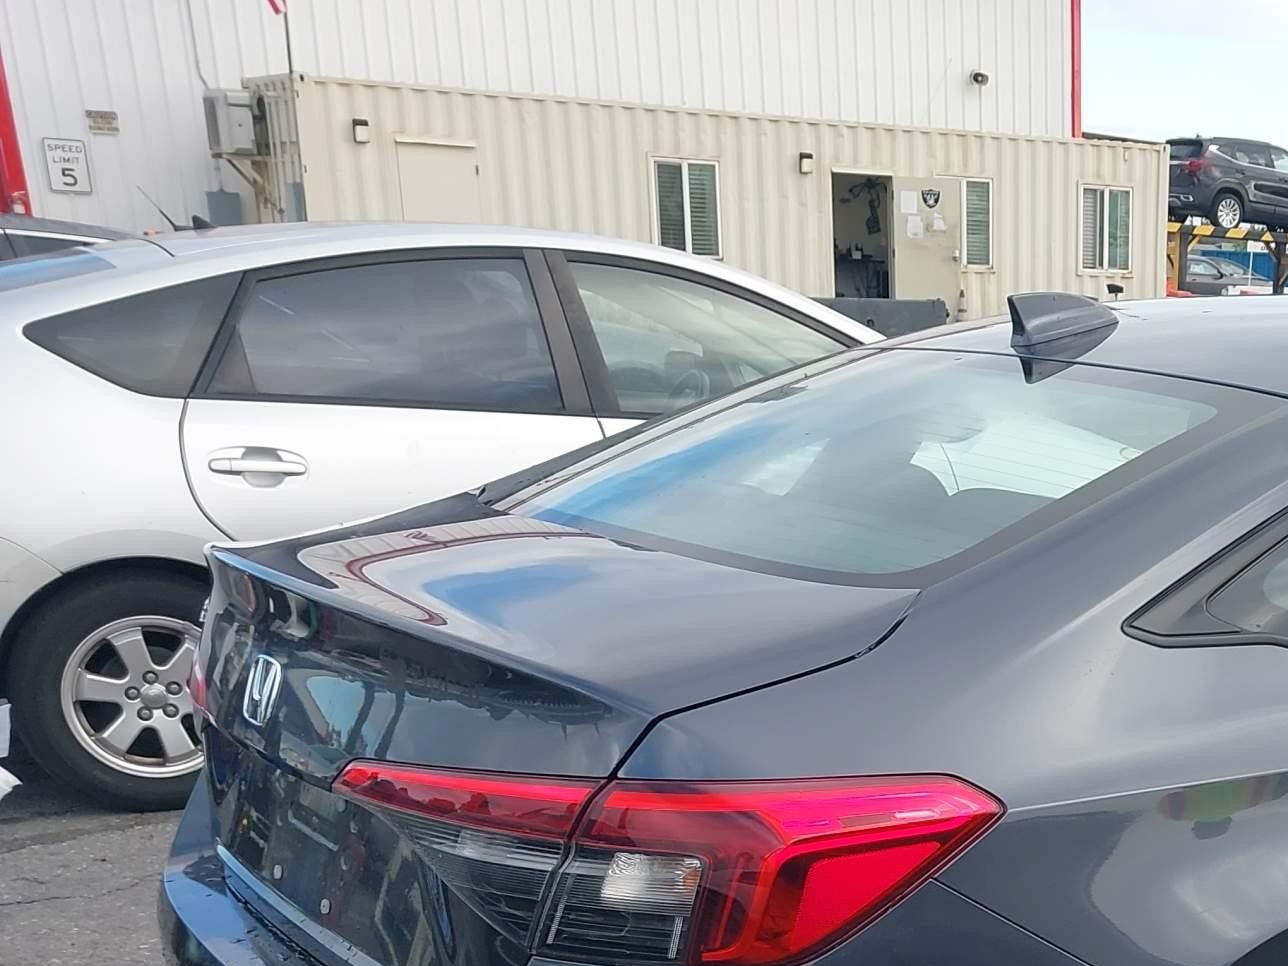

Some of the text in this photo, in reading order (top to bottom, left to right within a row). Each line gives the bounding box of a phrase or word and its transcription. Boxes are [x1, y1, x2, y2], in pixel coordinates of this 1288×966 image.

[47, 144, 82, 153] SPEED
[53, 156, 80, 164] LIMIT
[61, 168, 78, 186] 5
